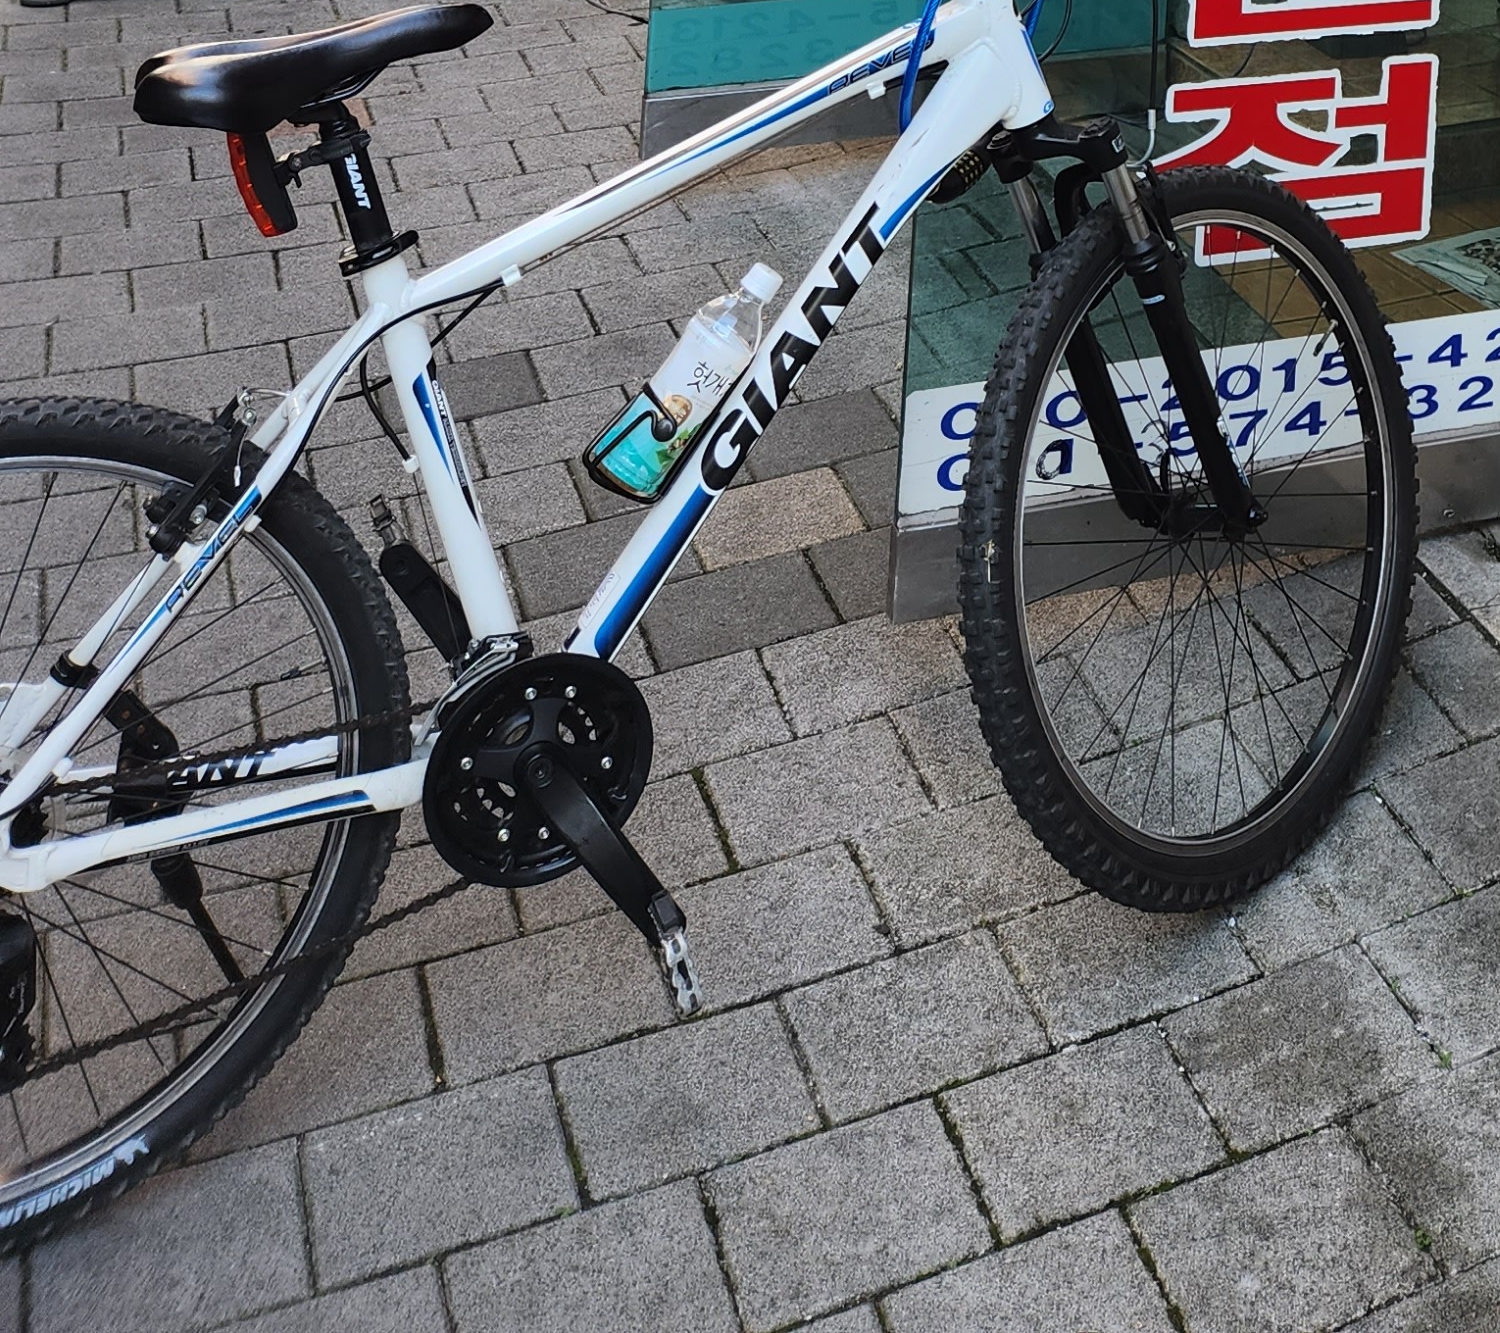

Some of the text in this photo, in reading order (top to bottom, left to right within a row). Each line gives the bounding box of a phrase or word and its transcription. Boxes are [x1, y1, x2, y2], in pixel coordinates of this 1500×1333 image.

[827, 31, 936, 97] REVE
[700, 200, 885, 491] GIANT
[431, 379, 448, 417] GIANT
[686, 361, 732, 398] 헛개
[164, 501, 254, 615] REVEL
[165, 749, 278, 786] ANT
[0, 1154, 116, 1229] MICHELIN
